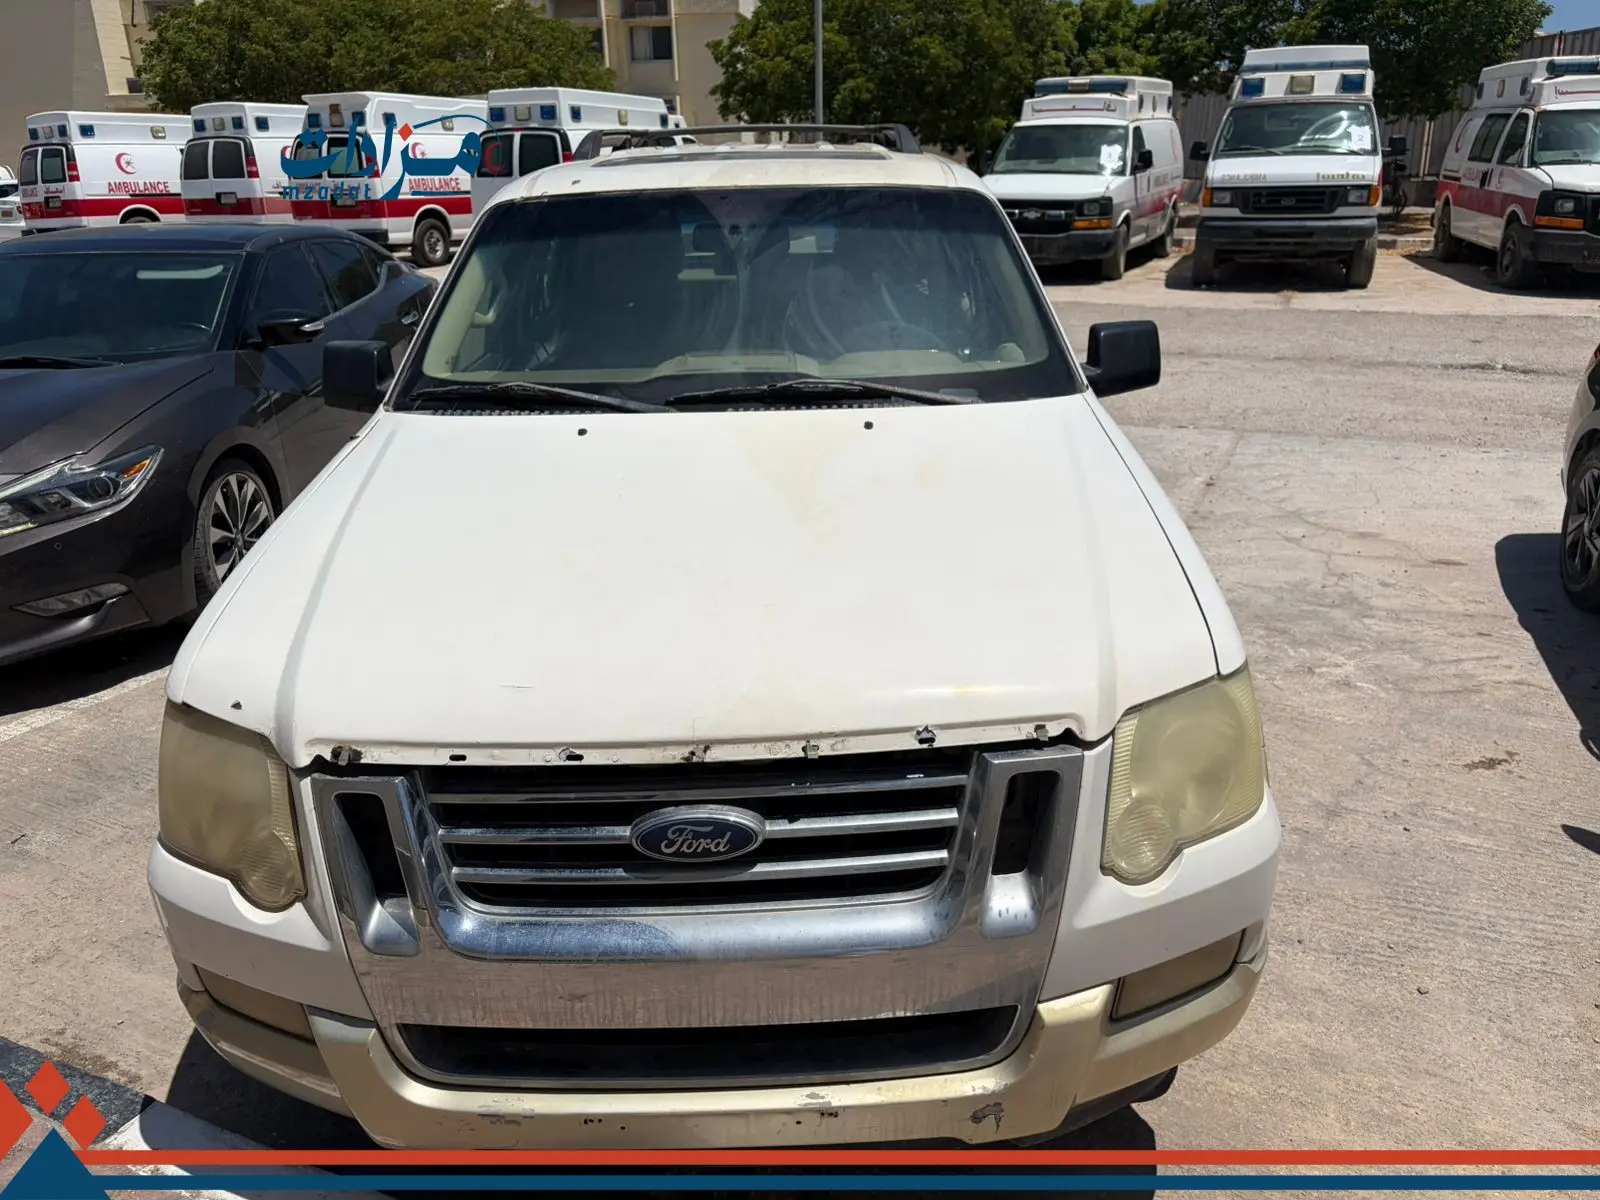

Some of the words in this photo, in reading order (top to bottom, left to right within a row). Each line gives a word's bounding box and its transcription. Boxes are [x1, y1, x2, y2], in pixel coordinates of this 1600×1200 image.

[107, 181, 170, 194] AMBULANCE
[408, 177, 461, 191] AMBULANCE
[660, 824, 732, 854] Ford
